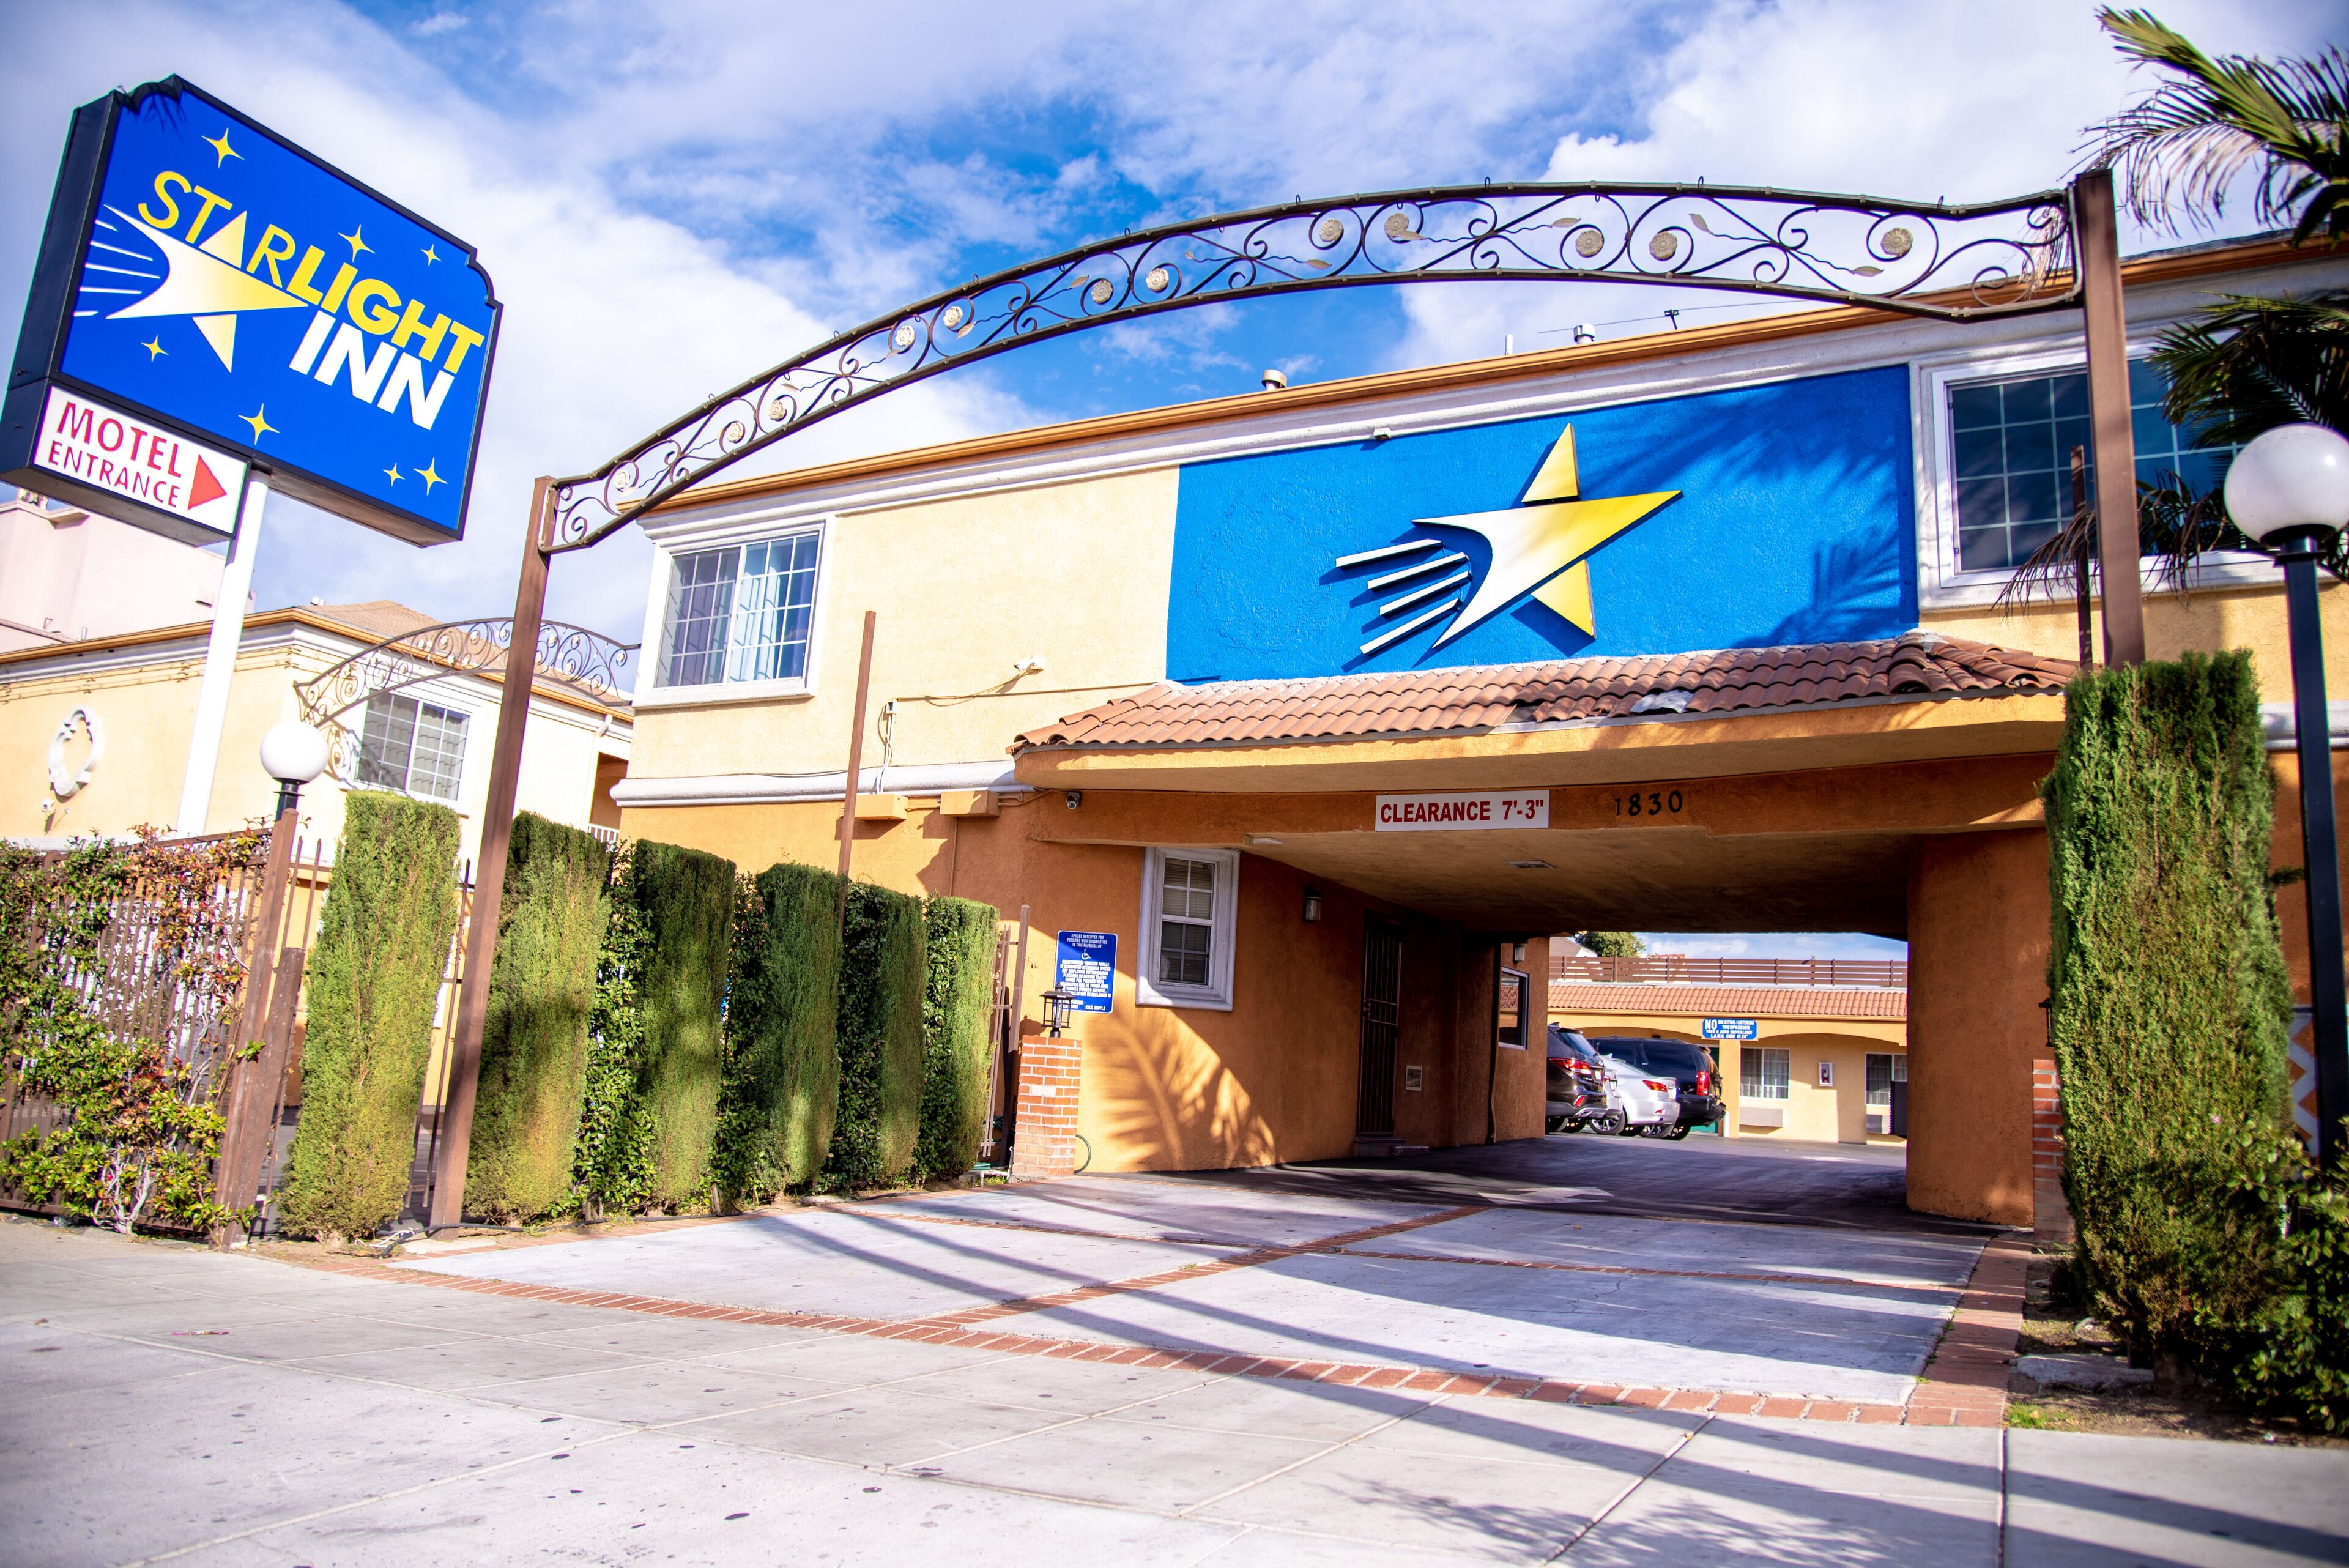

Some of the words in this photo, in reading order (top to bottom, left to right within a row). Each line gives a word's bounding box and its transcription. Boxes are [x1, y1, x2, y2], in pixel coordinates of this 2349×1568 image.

[138, 171, 485, 374] STARLIGHT
[289, 311, 455, 431] INN
[48, 440, 180, 509] ENTRANCE
[57, 402, 182, 479] MOTEL
[1380, 801, 1490, 823] CLEARANCE
[1502, 799, 1544, 820] 7'-3"
[1616, 790, 1683, 817] 1830
[1705, 1019, 1717, 1030] NO
